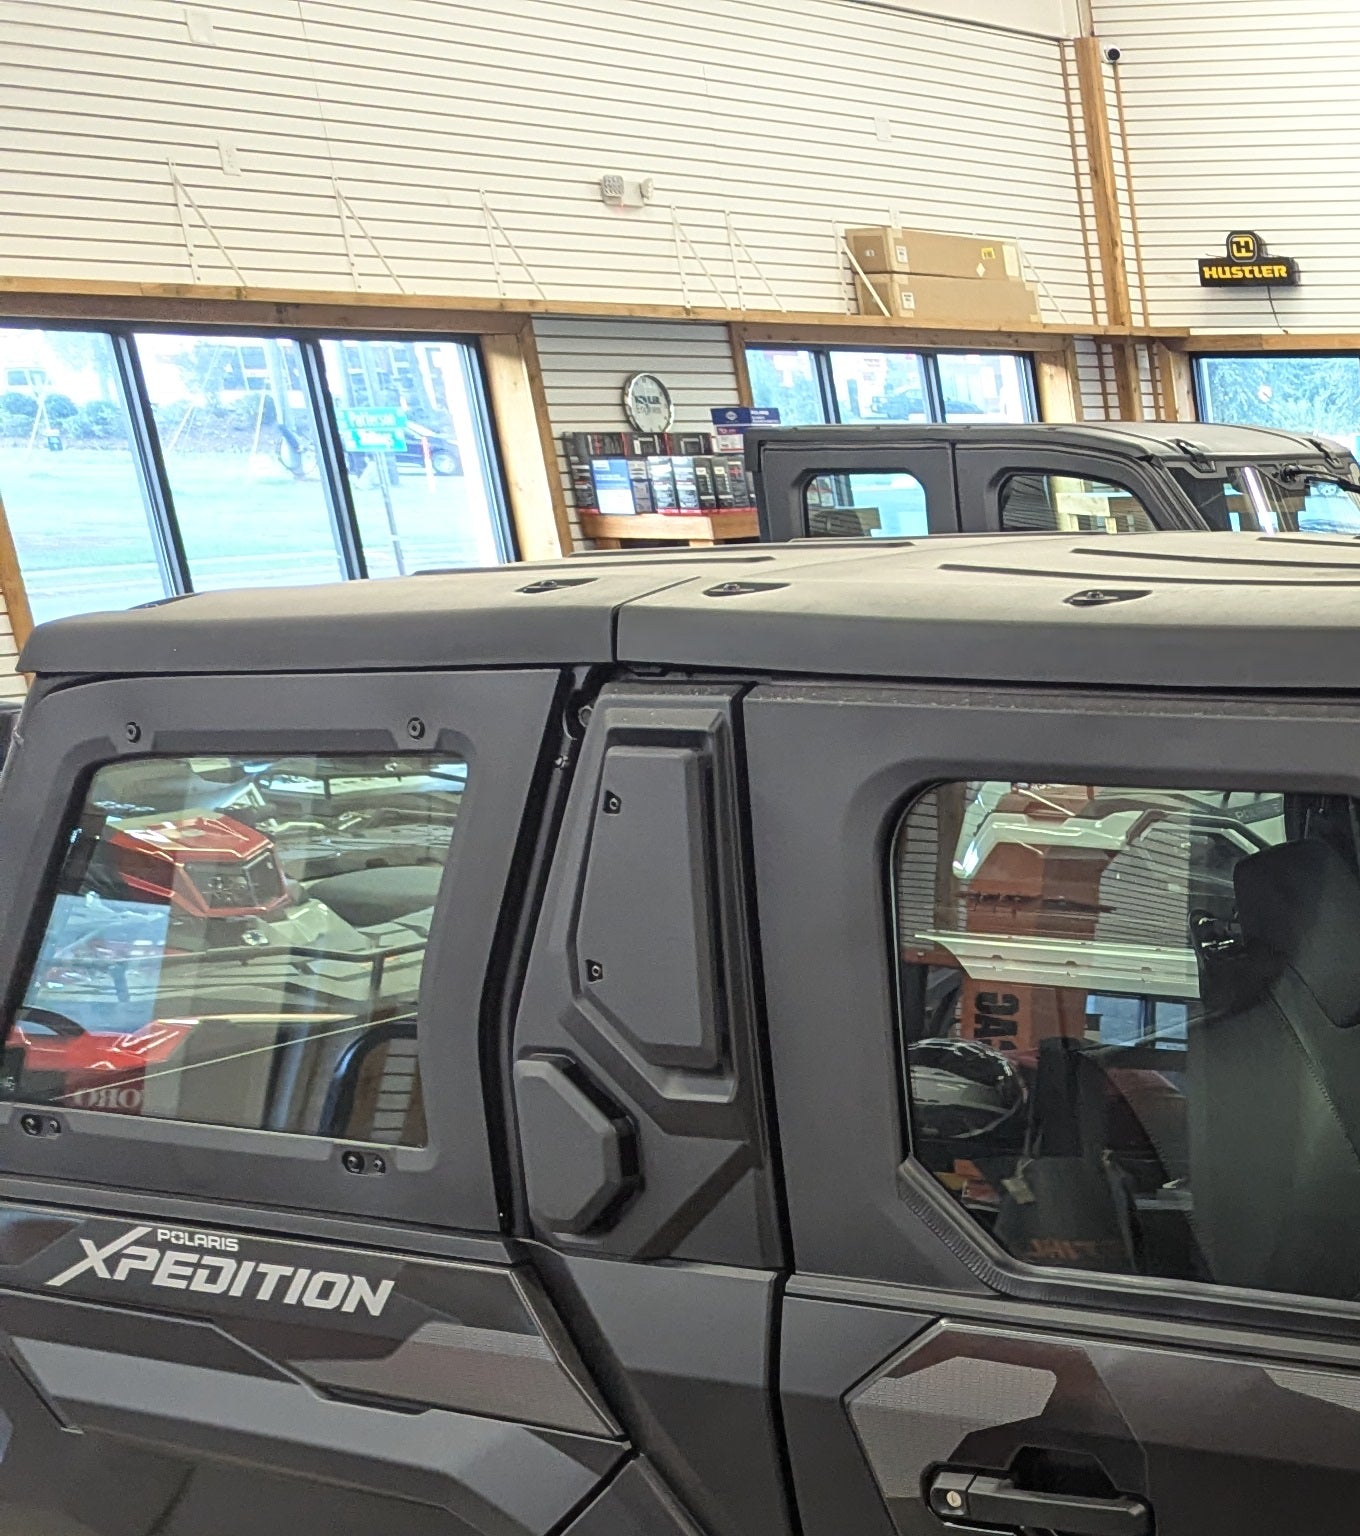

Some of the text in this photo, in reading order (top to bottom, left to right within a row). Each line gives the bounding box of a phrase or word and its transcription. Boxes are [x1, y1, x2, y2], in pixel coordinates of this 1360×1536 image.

[1203, 265, 1287, 278] HUSTLER
[157, 1229, 239, 1252] POLARIS
[44, 1226, 396, 1317] XPEDITION
